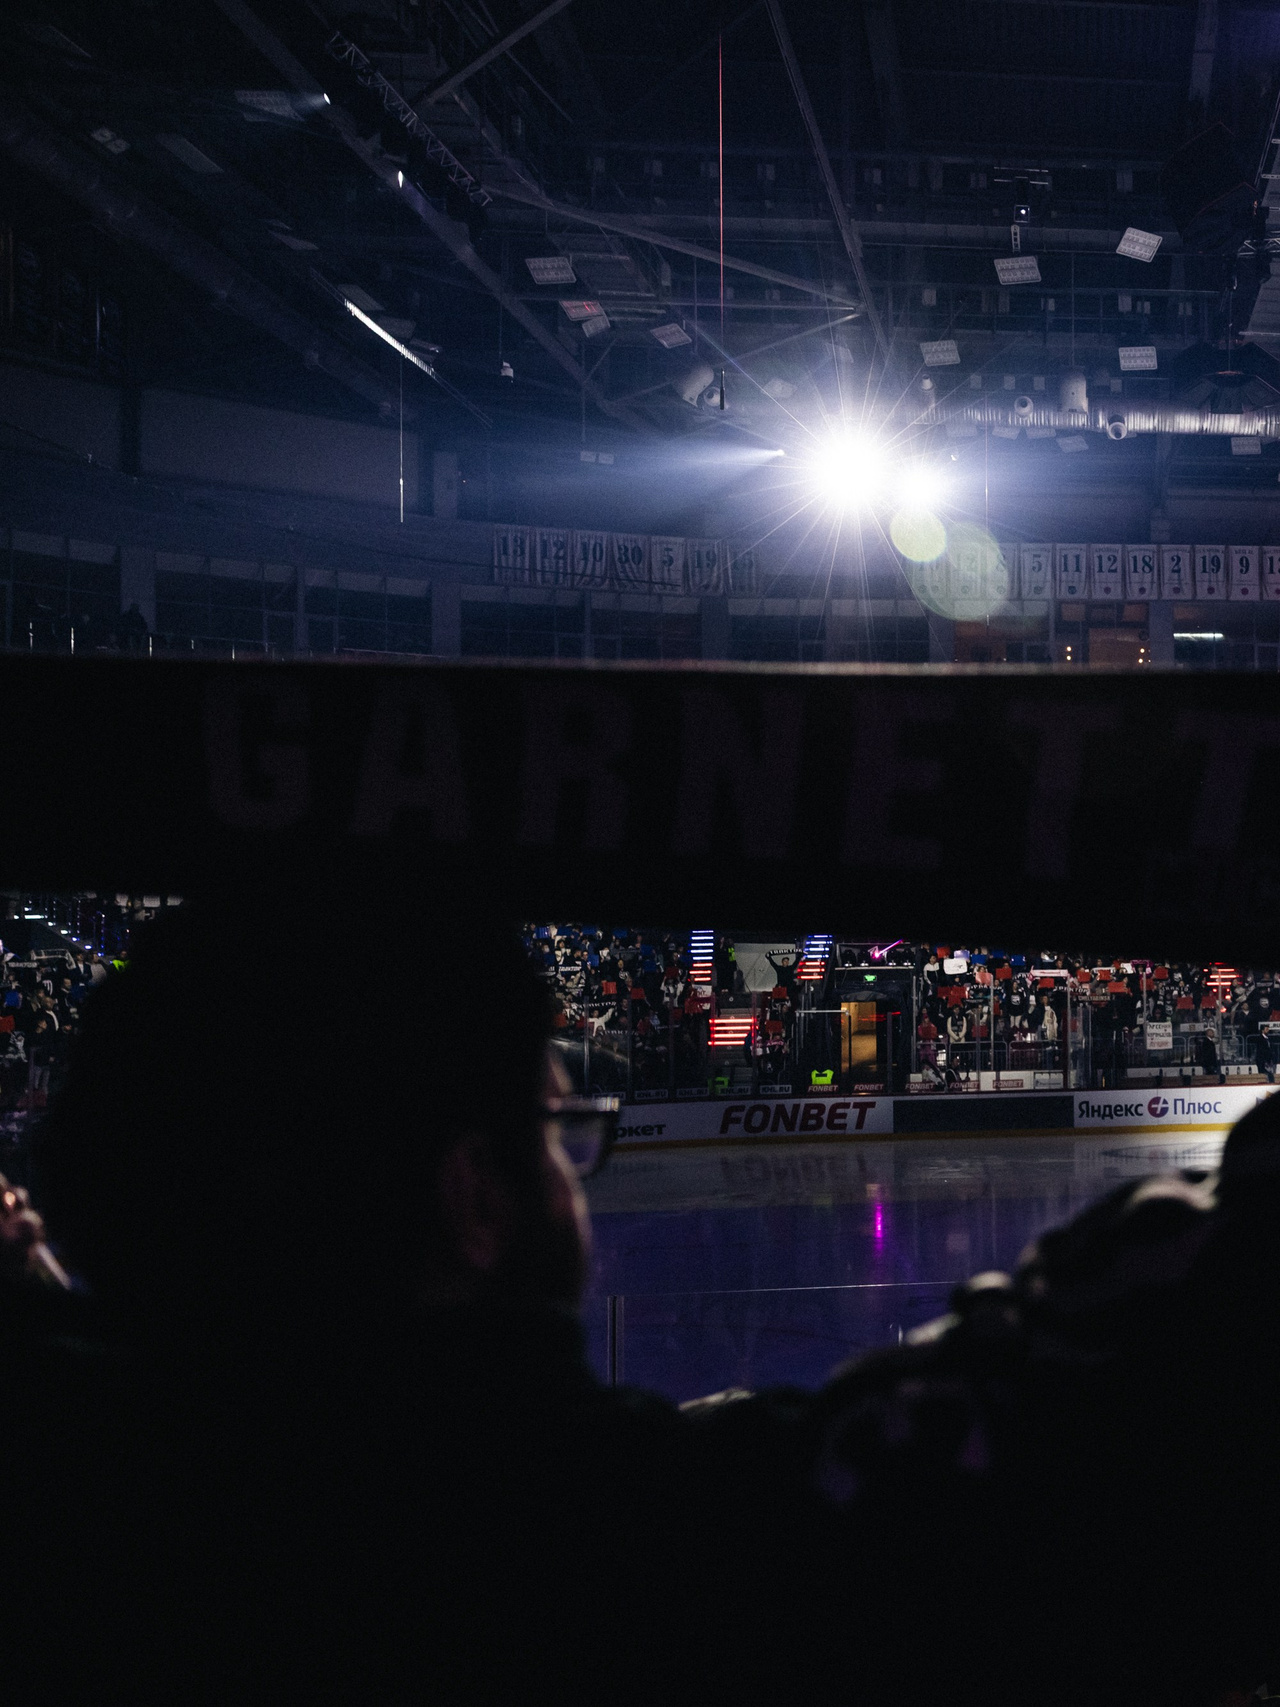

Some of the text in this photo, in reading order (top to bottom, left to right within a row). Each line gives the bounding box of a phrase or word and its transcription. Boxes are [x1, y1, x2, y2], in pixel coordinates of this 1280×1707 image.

[1031, 554, 1042, 573] 5
[1061, 553, 1082, 573] 11
[1096, 554, 1118, 573] 12
[1131, 554, 1154, 574] 18
[1170, 555, 1182, 574] 2
[1200, 555, 1222, 574] 19
[1239, 556, 1250, 575] 9
[807, 1085, 838, 1093] FONBET
[853, 1083, 884, 1091] FONBET
[720, 1101, 876, 1134] FONBET
[1078, 1098, 1222, 1120] Яндекс Плюс
[613, 1123, 667, 1140] ркет
